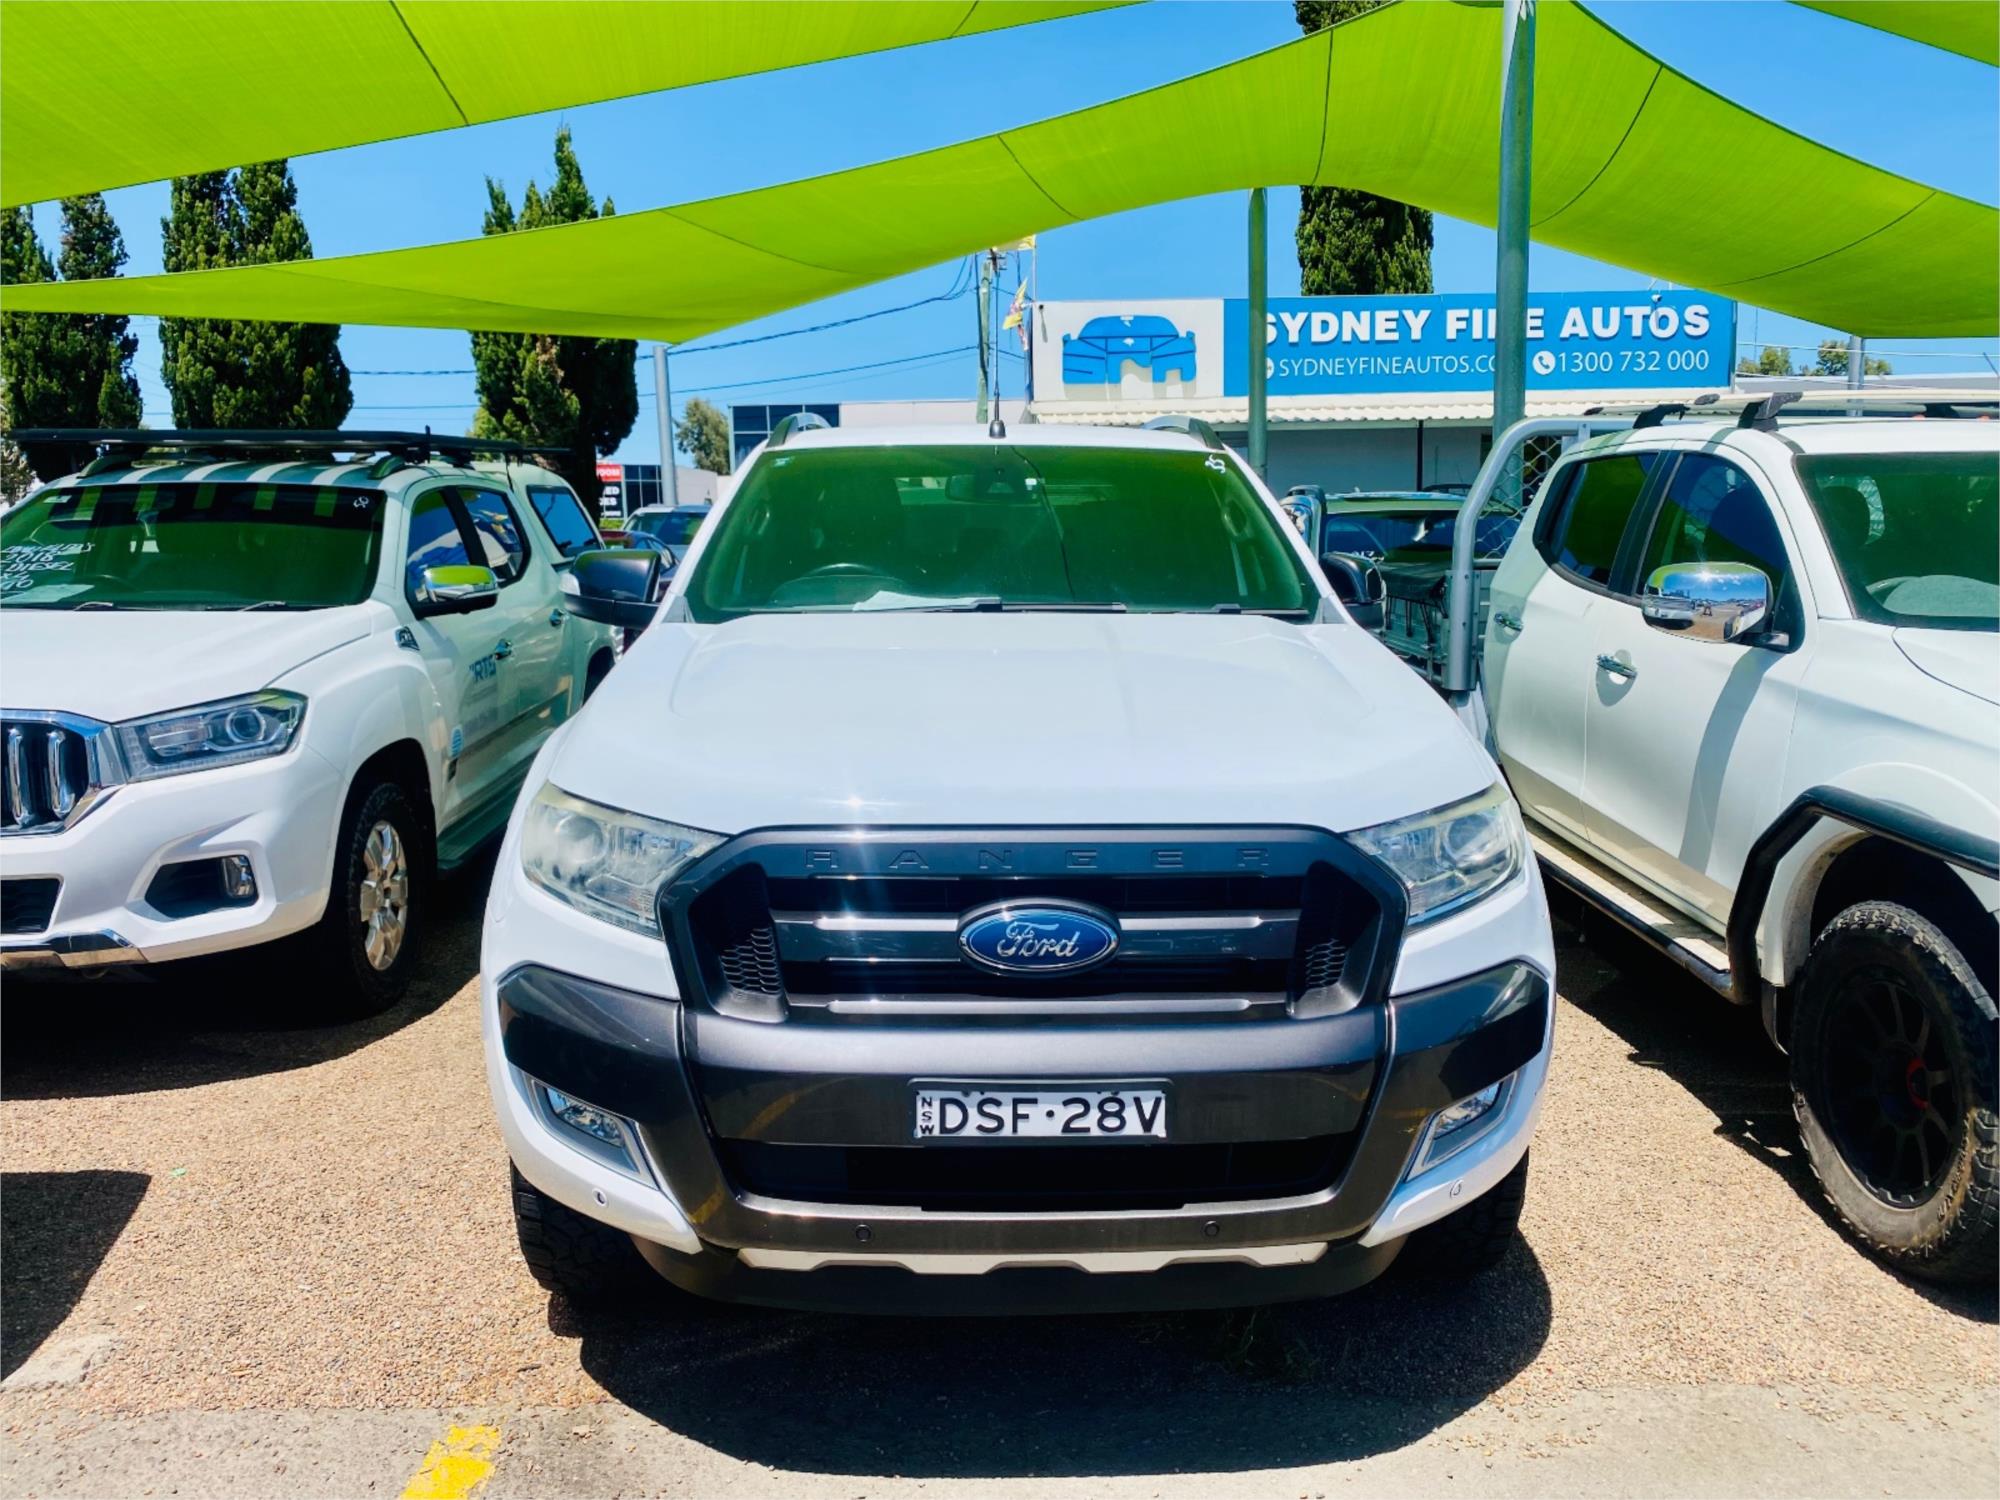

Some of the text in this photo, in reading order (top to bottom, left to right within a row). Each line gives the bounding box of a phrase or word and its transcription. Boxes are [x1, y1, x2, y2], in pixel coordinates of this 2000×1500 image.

[1559, 304, 1710, 339] AUTOS
[1559, 349, 1709, 373] 1300 732 000
[804, 848, 1270, 869] RANGER
[996, 921, 1081, 958] Ford
